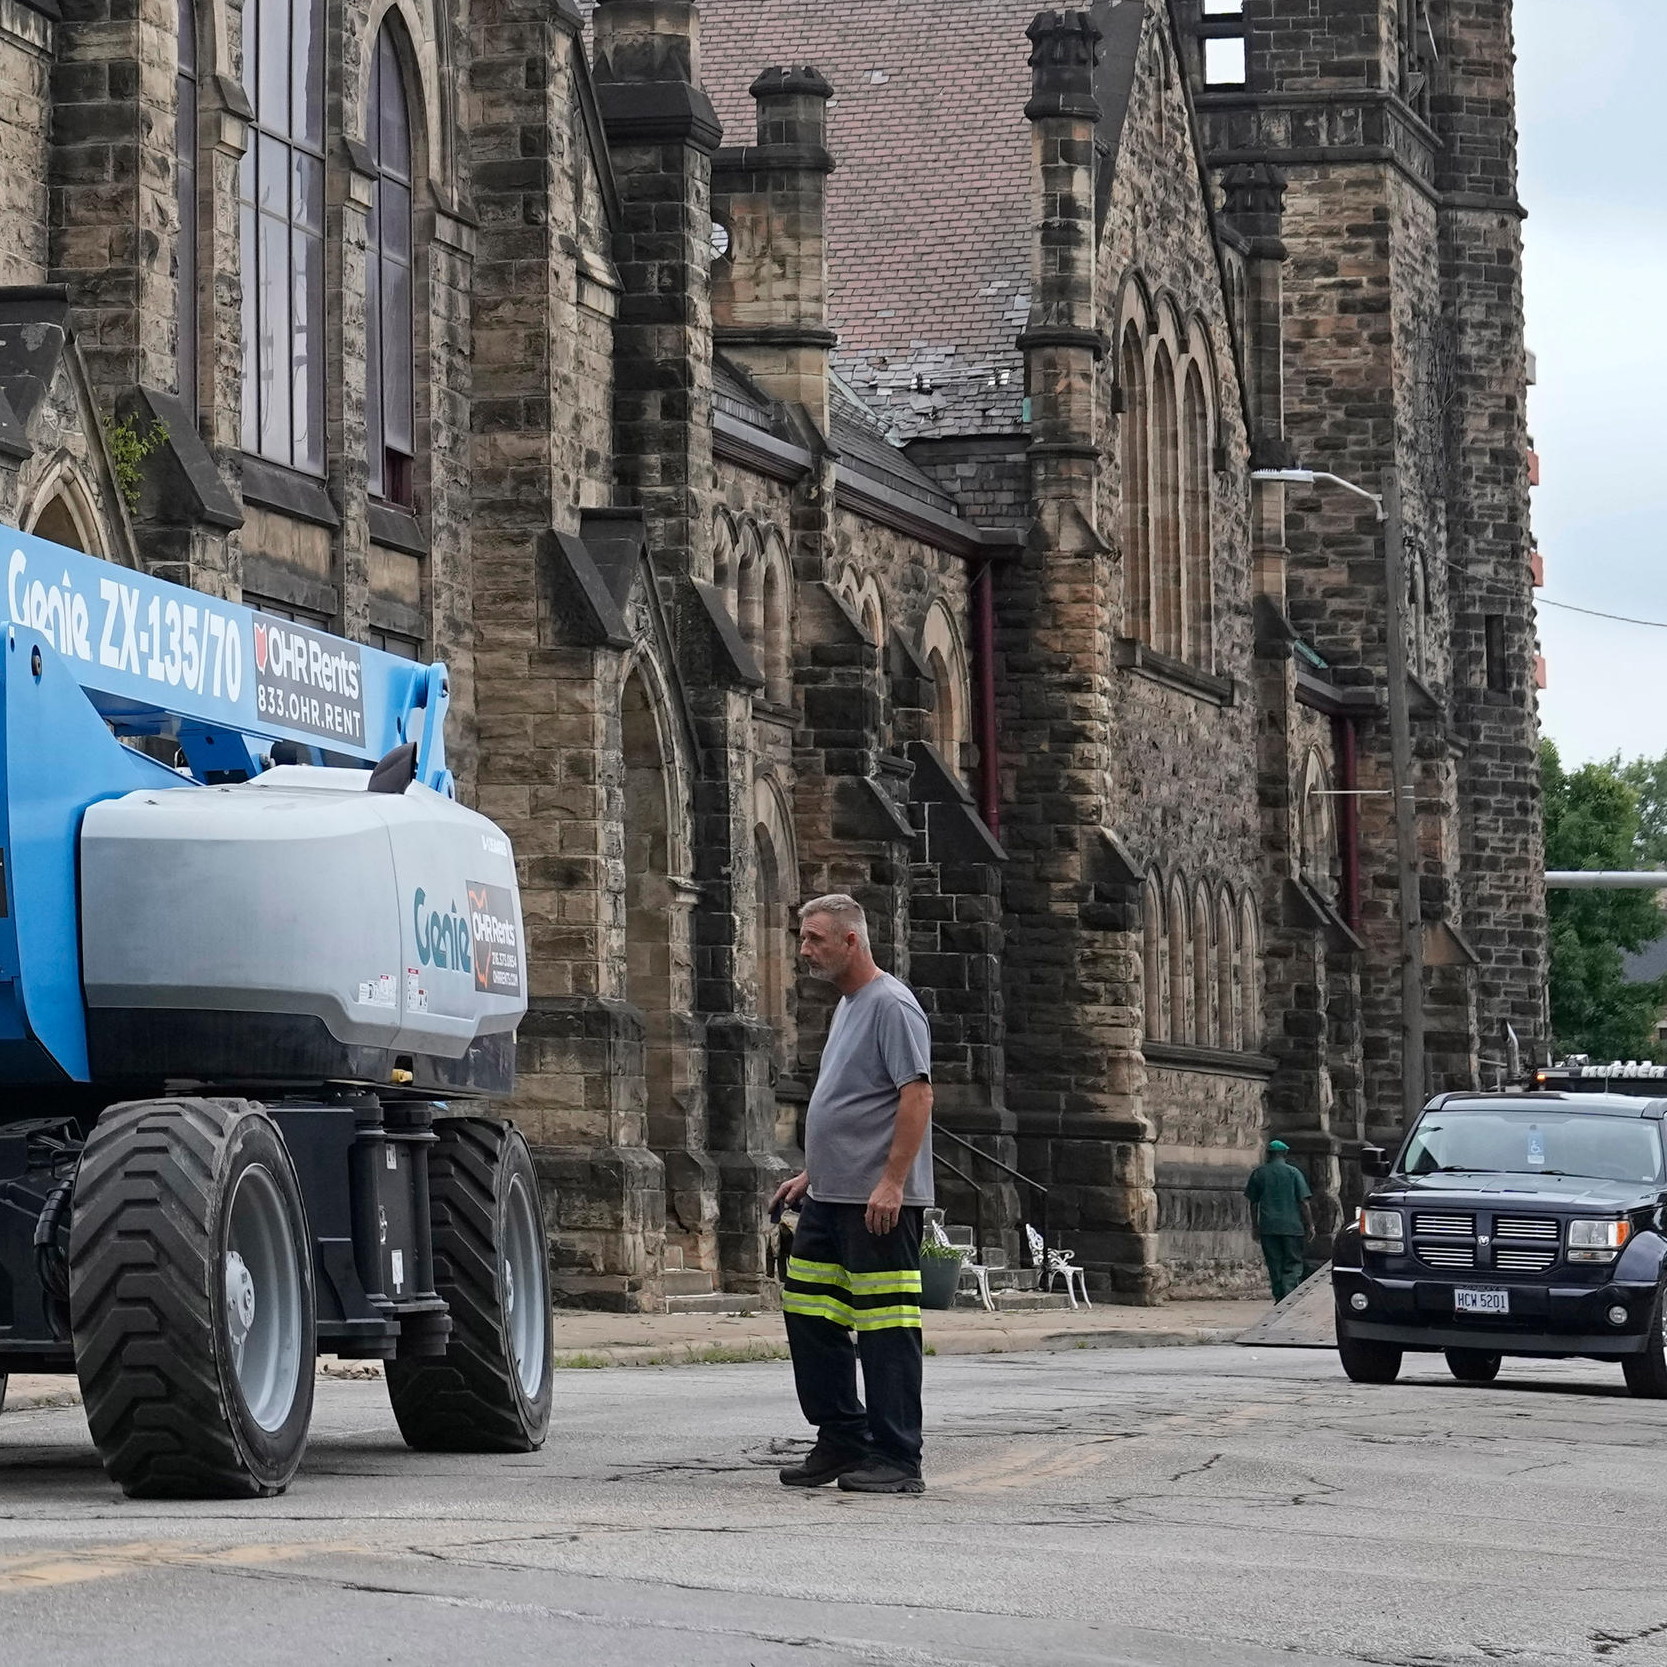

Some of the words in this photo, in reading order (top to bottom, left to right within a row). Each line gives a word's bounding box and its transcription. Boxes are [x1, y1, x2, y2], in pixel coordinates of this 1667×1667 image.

[8, 549, 92, 662] Genie
[99, 577, 242, 703] ZX-135/70
[269, 627, 309, 683] OHR
[309, 640, 360, 700] Rents
[257, 684, 361, 737] 833.OHR.RENT
[414, 887, 470, 973] Genie
[473, 911, 493, 942] OHR
[1458, 1293, 1477, 1307] HCW
[1480, 1294, 1505, 1308] 5201
